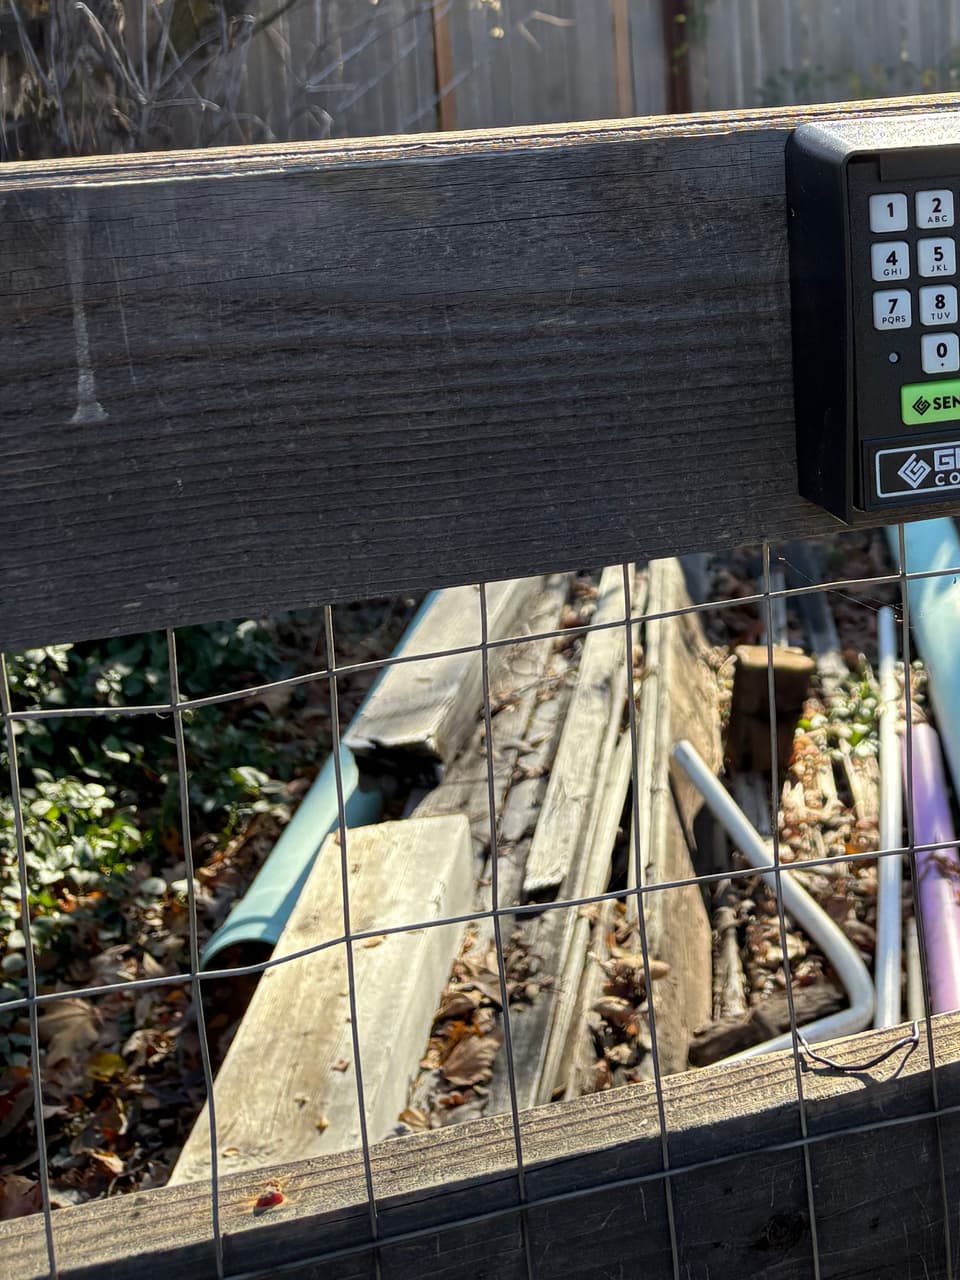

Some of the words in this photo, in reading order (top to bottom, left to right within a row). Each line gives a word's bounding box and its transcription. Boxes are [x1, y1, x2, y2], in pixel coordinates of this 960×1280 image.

[887, 202, 894, 217] 1
[932, 198, 941, 213] 2
[928, 215, 947, 223] ABC
[886, 251, 897, 266] 4
[934, 247, 943, 261] 5
[883, 268, 901, 276] GHI
[888, 299, 898, 314] 7
[935, 294, 945, 309] 8
[882, 315, 906, 324] PQRS
[931, 312, 950, 320] TUV
[937, 343, 947, 358] 0
